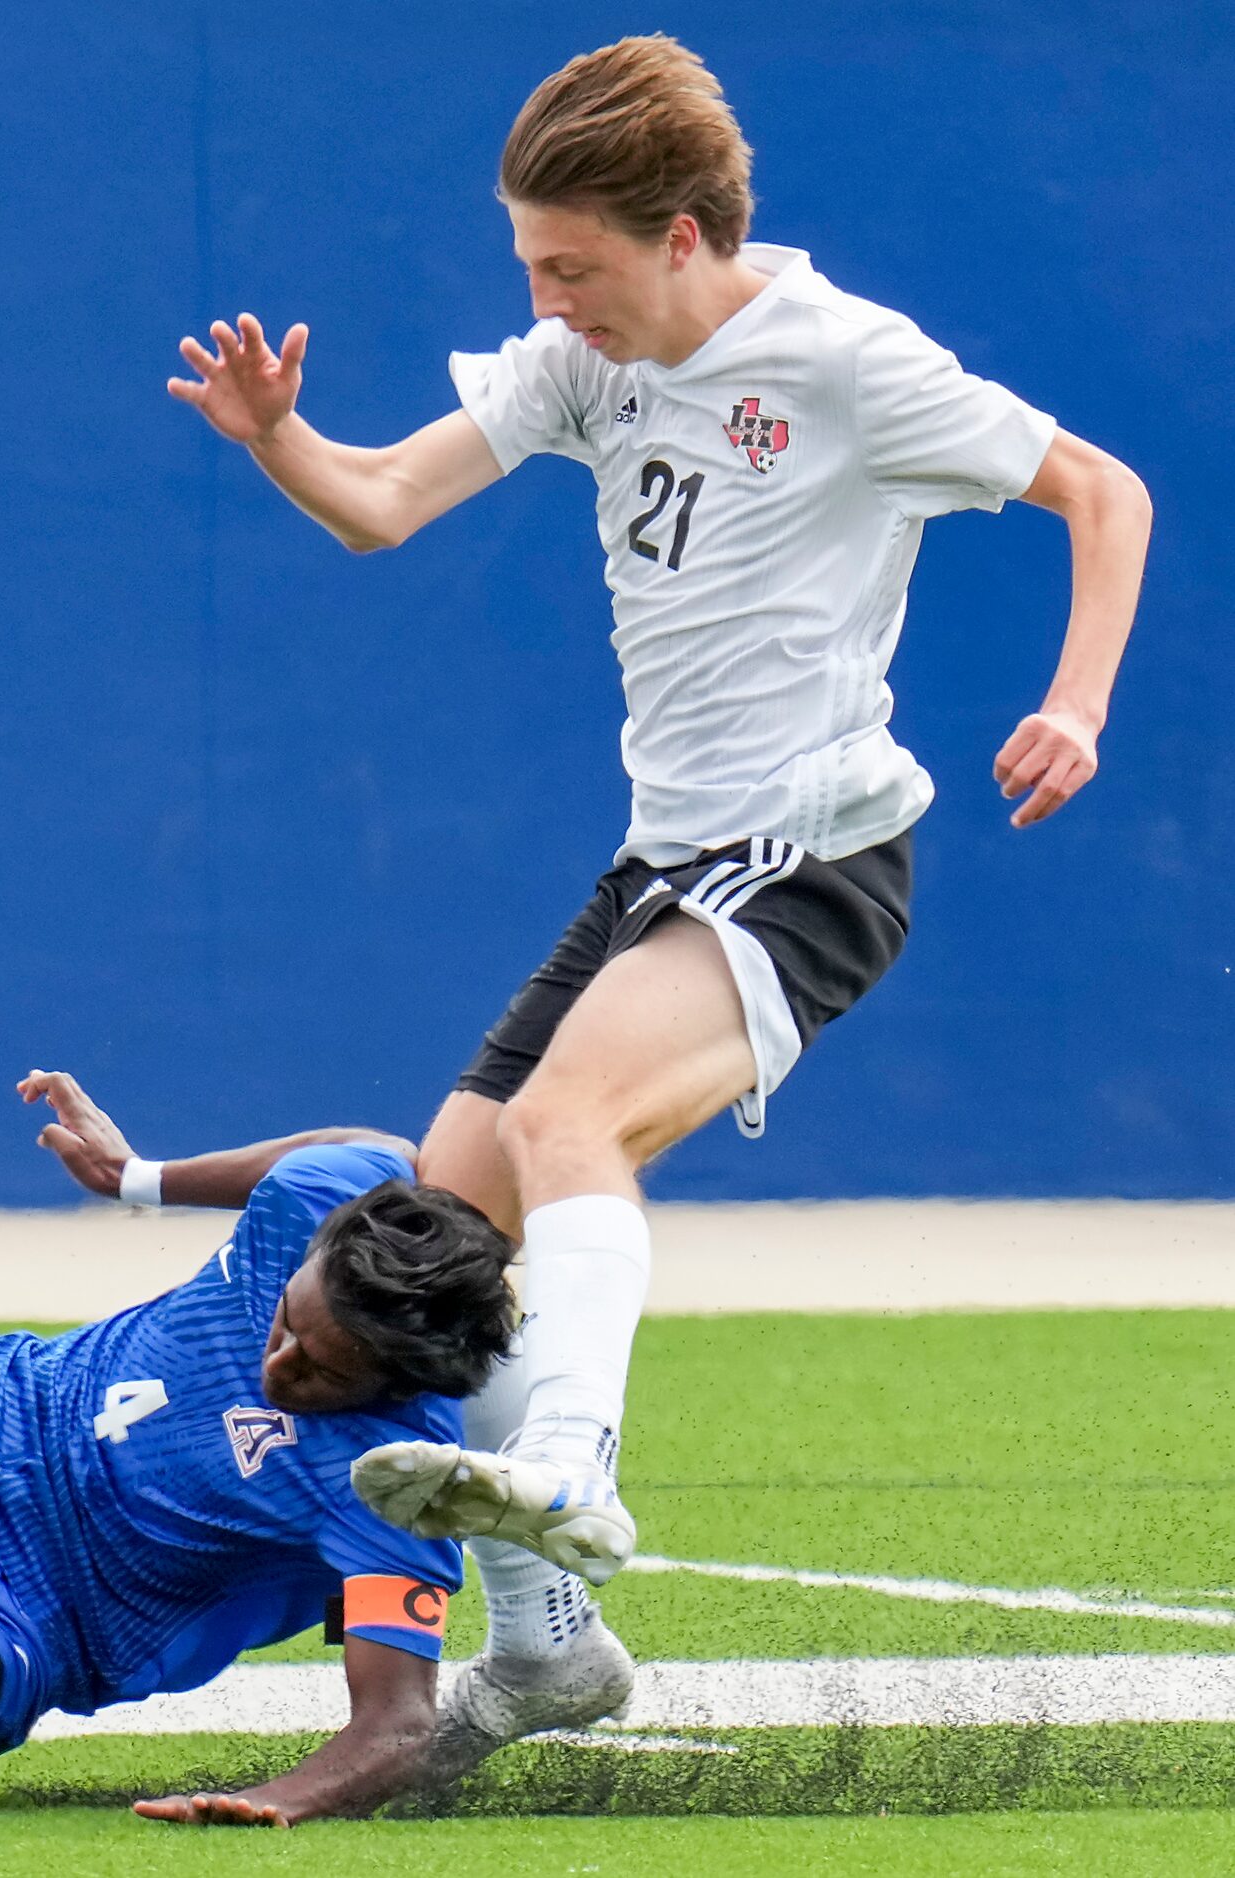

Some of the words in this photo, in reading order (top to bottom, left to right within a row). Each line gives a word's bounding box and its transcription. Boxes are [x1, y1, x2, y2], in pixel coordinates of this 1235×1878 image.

[629, 460, 705, 571] 21
[93, 1379, 169, 1444] 4
[222, 1404, 298, 1479] A
[403, 1584, 442, 1626] C
